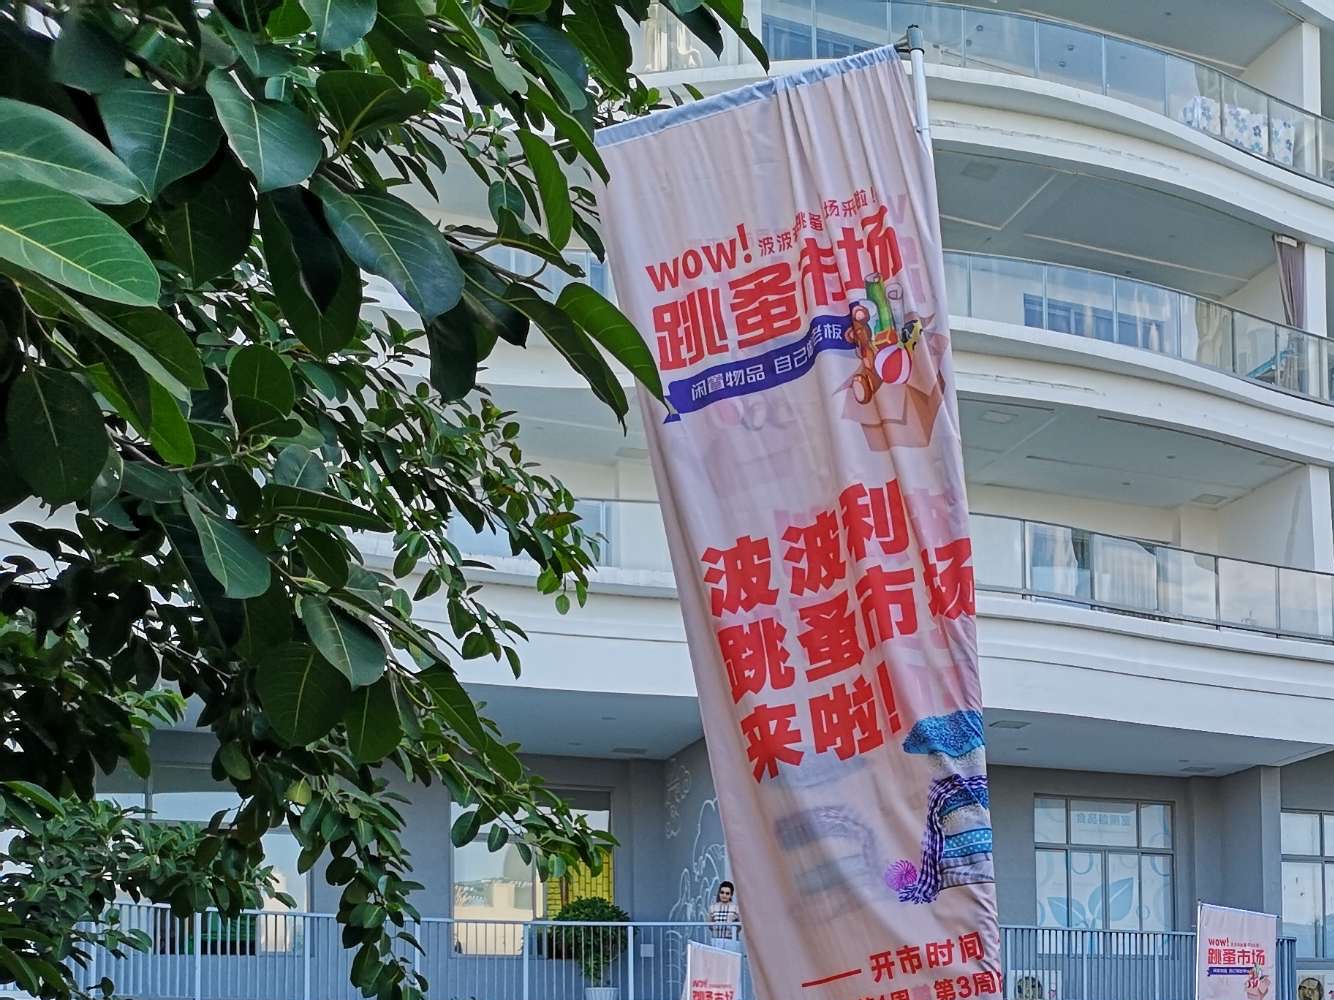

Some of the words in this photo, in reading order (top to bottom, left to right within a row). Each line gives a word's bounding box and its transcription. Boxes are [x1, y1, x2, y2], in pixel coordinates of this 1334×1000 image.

[651, 205, 905, 371] 跳蚤市场
[691, 364, 766, 401] 闲置物品
[701, 478, 910, 618] 波波利
[717, 537, 977, 704] 跳蚤市场
[740, 660, 902, 784] 来啦！
[869, 931, 985, 983] 开市时间
[1207, 949, 1266, 966] 跳蚤市场
